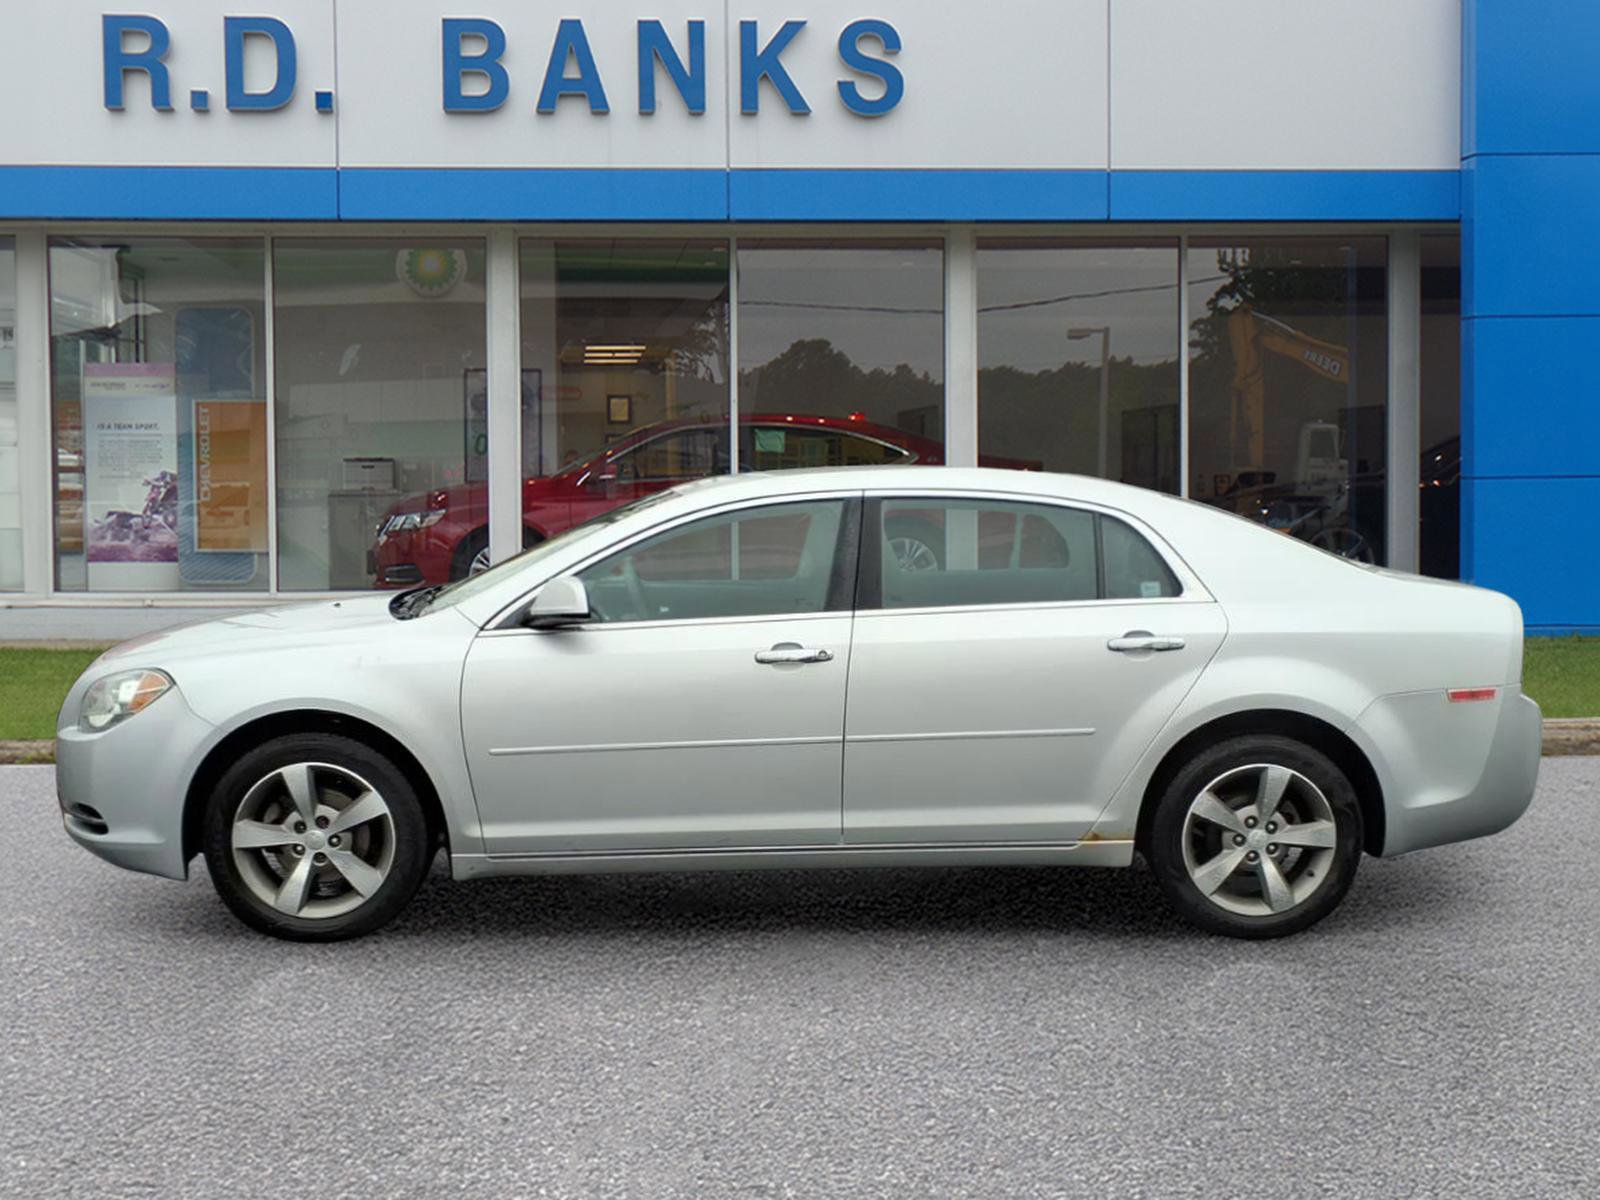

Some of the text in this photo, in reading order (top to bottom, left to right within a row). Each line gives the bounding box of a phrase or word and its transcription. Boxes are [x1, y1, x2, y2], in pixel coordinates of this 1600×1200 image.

[103, 14, 905, 119] R.D. BANKS
[114, 422, 133, 430] TEAM
[200, 405, 211, 501] CHEVROLET
